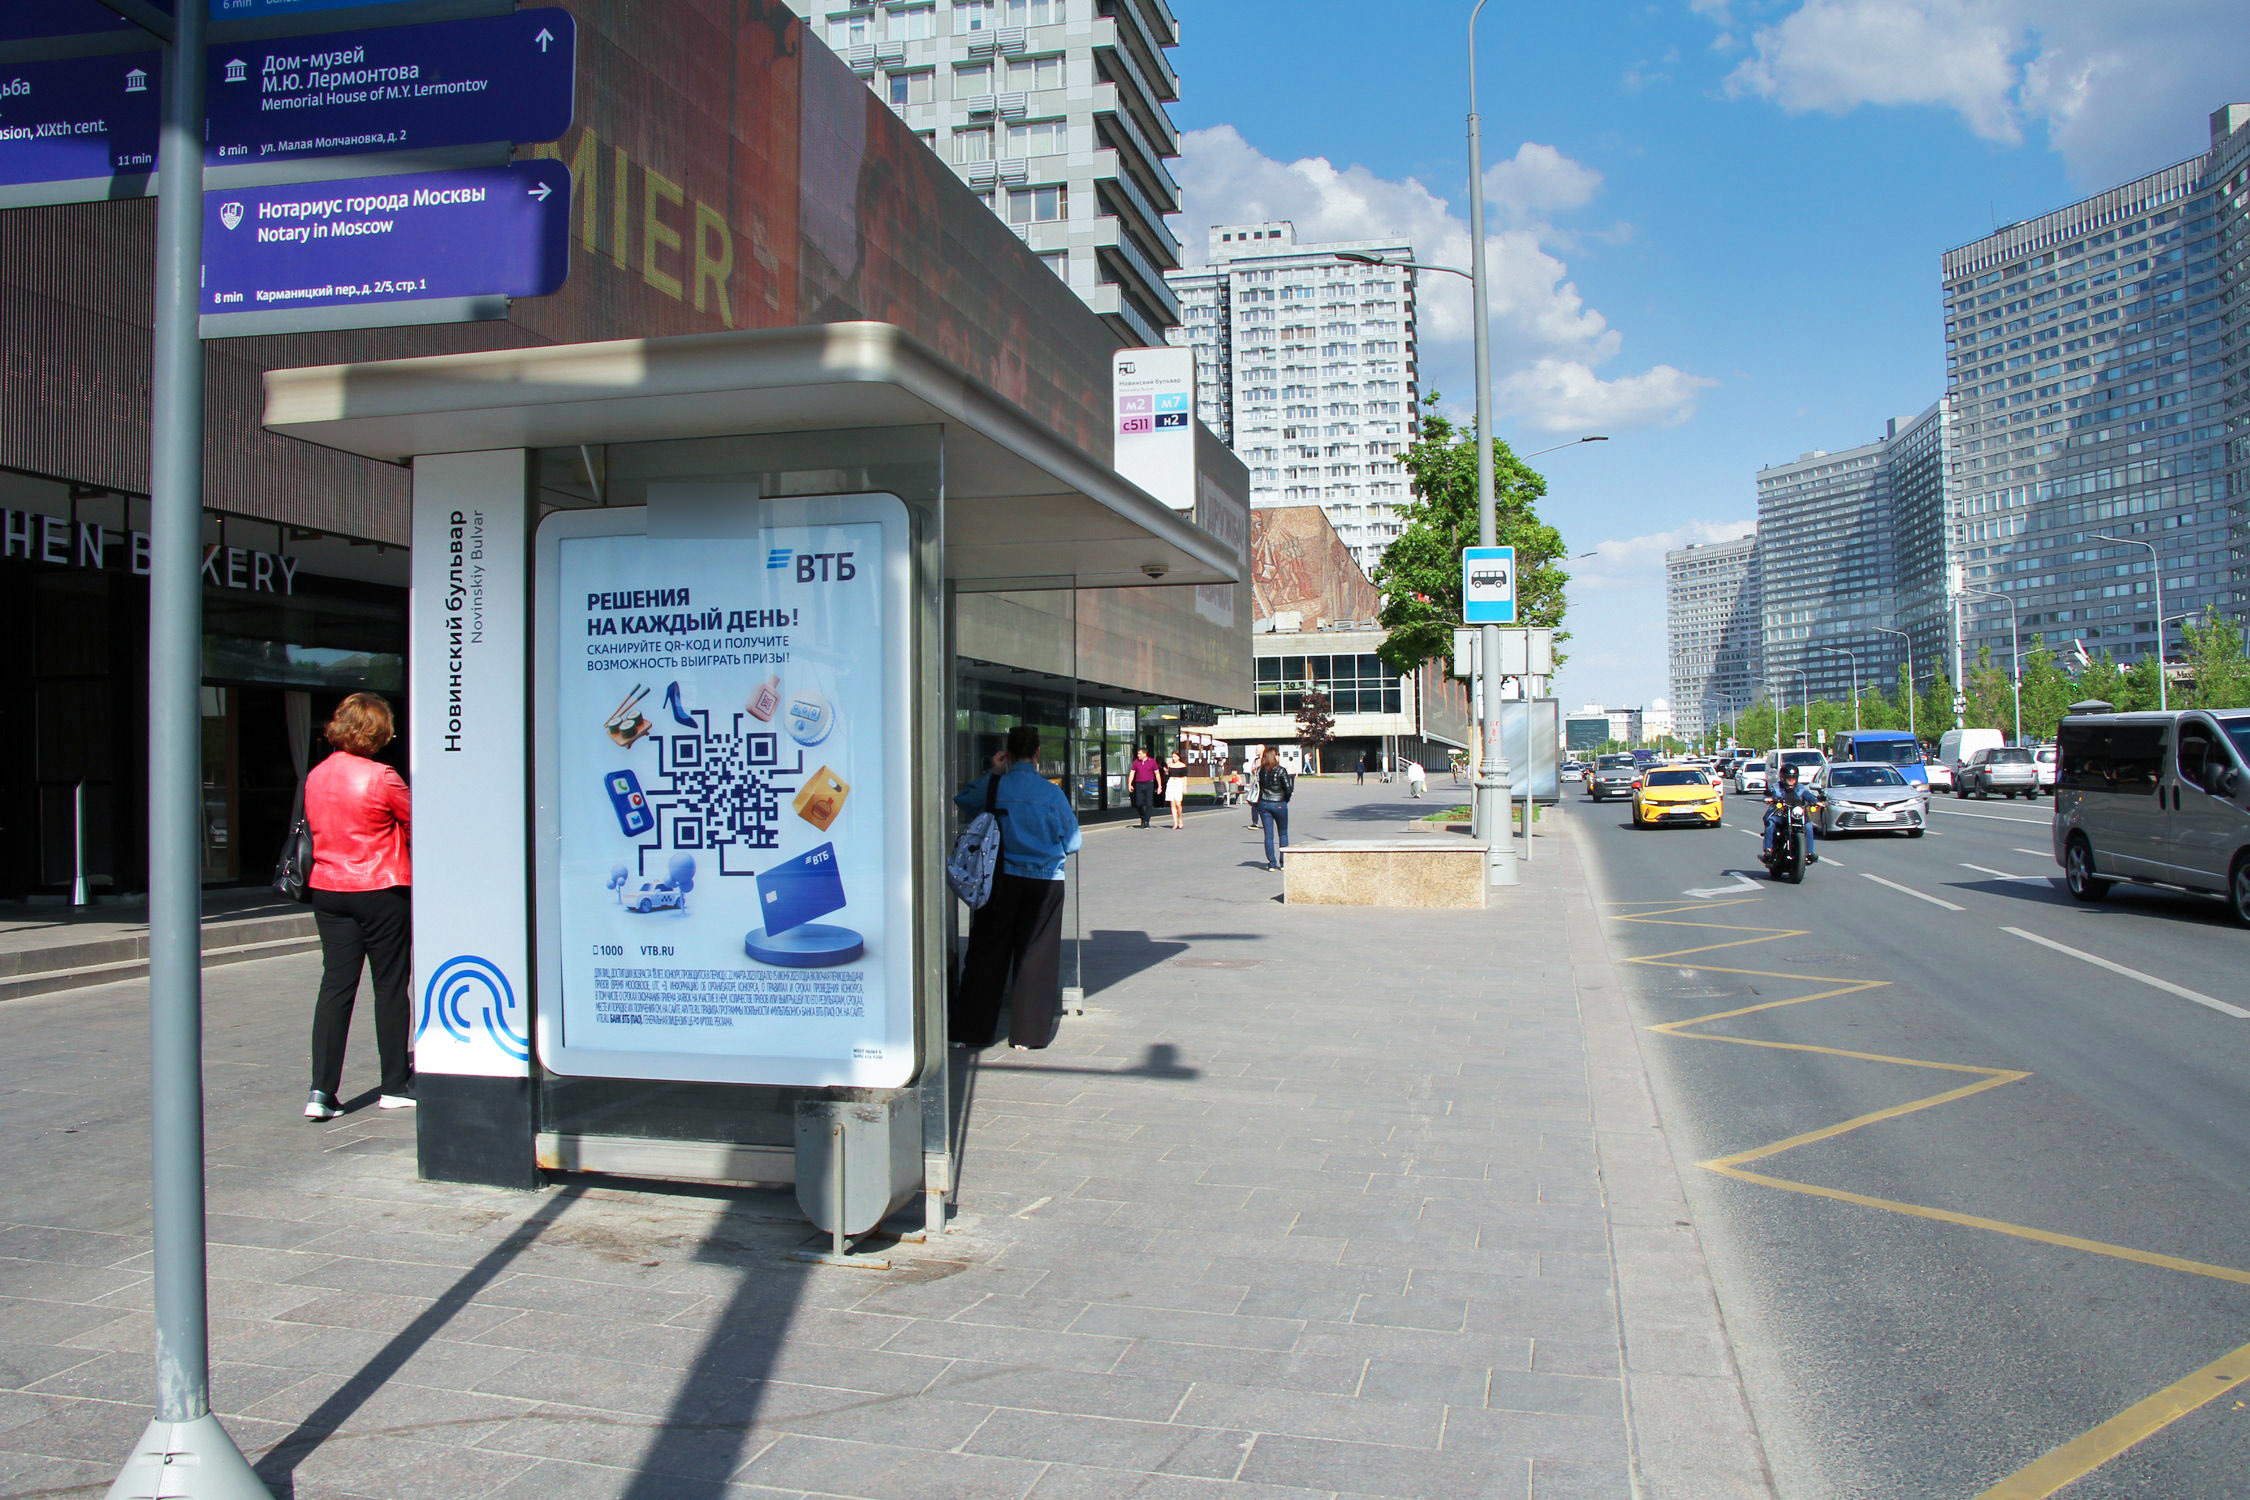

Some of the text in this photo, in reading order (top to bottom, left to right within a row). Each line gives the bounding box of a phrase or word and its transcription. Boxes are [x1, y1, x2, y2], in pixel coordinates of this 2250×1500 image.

[262, 46, 365, 76] Дом-музей
[0, 78, 31, 99] ьба
[262, 65, 419, 93] М.Ю. Лермонтова
[262, 79, 488, 111] Memorial House of M.Y. Lermontov
[35, 121, 71, 137] XIXth
[74, 119, 108, 134] cent.
[219, 144, 248, 156] 8 min
[260, 130, 407, 155] ул. Малая Молчановка, д. 2
[118, 153, 152, 166] 11 min
[258, 187, 486, 220] Нотариус города Москвы
[257, 219, 394, 243] Notary in Moscow
[214, 292, 243, 303] 8 min
[256, 284, 333, 301] Карманицкий
[362, 283, 373, 295] д.
[374, 280, 394, 293] 2/5,
[395, 279, 418, 292] стр.
[420, 278, 427, 289] 1
[4, 508, 104, 570] HEN
[131, 530, 299, 596] BKERY
[796, 551, 856, 584] ВТБ
[471, 509, 486, 644] Novinskiy Bulvar
[587, 588, 690, 611] РЕШЕНИЯ
[444, 510, 467, 752] Новинский бульвар
[587, 608, 799, 636] НА КАЖДЫЙ ДЕНЬ!
[586, 636, 790, 656] СКАНИРУЙТЕ QR-КОД И ПОЛУЧИТЕ
[587, 652, 791, 672] ВОЗМОЖНОСТЬ ВЫИГРАТЬ ПРИЗЫ!
[812, 850, 829, 865] ВТБ
[600, 945, 675, 956] 1000 VTB.RU
